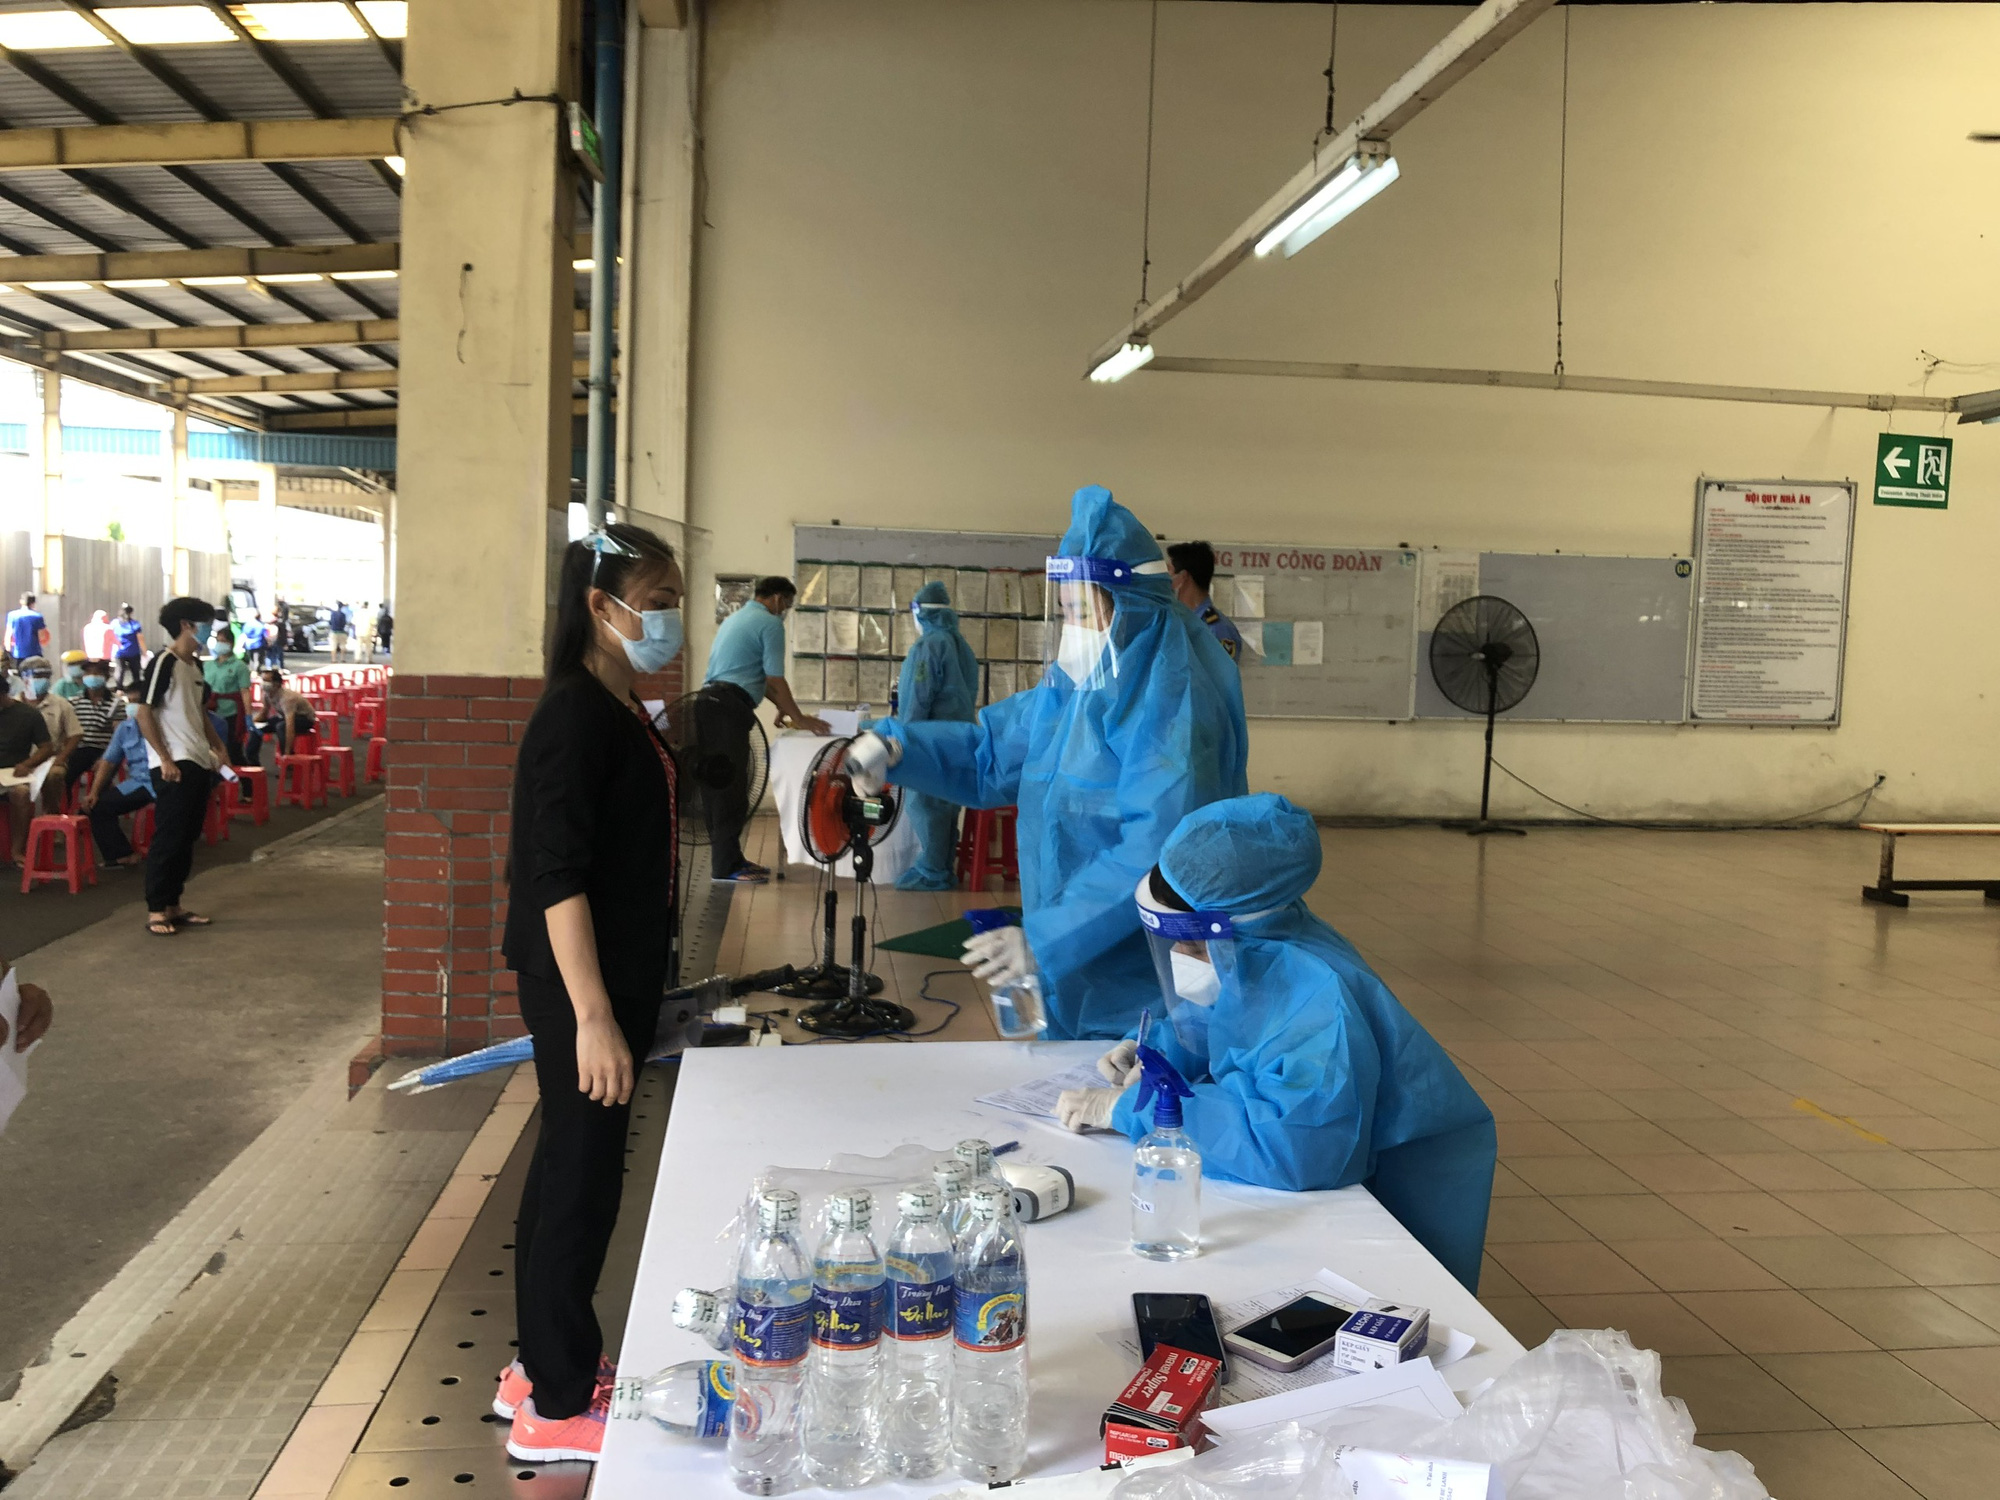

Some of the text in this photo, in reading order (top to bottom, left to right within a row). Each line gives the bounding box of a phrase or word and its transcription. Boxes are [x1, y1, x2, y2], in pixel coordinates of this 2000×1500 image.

[1761, 493, 1777, 504] QUY
[1239, 552, 1272, 568] TIN
[1276, 549, 1326, 570] CÔNG
[1332, 551, 1383, 572] ĐOÀN
[1351, 1313, 1373, 1332] SLECHO
[1160, 1352, 1179, 1374] maxell
[1141, 1372, 1169, 1399] Super
